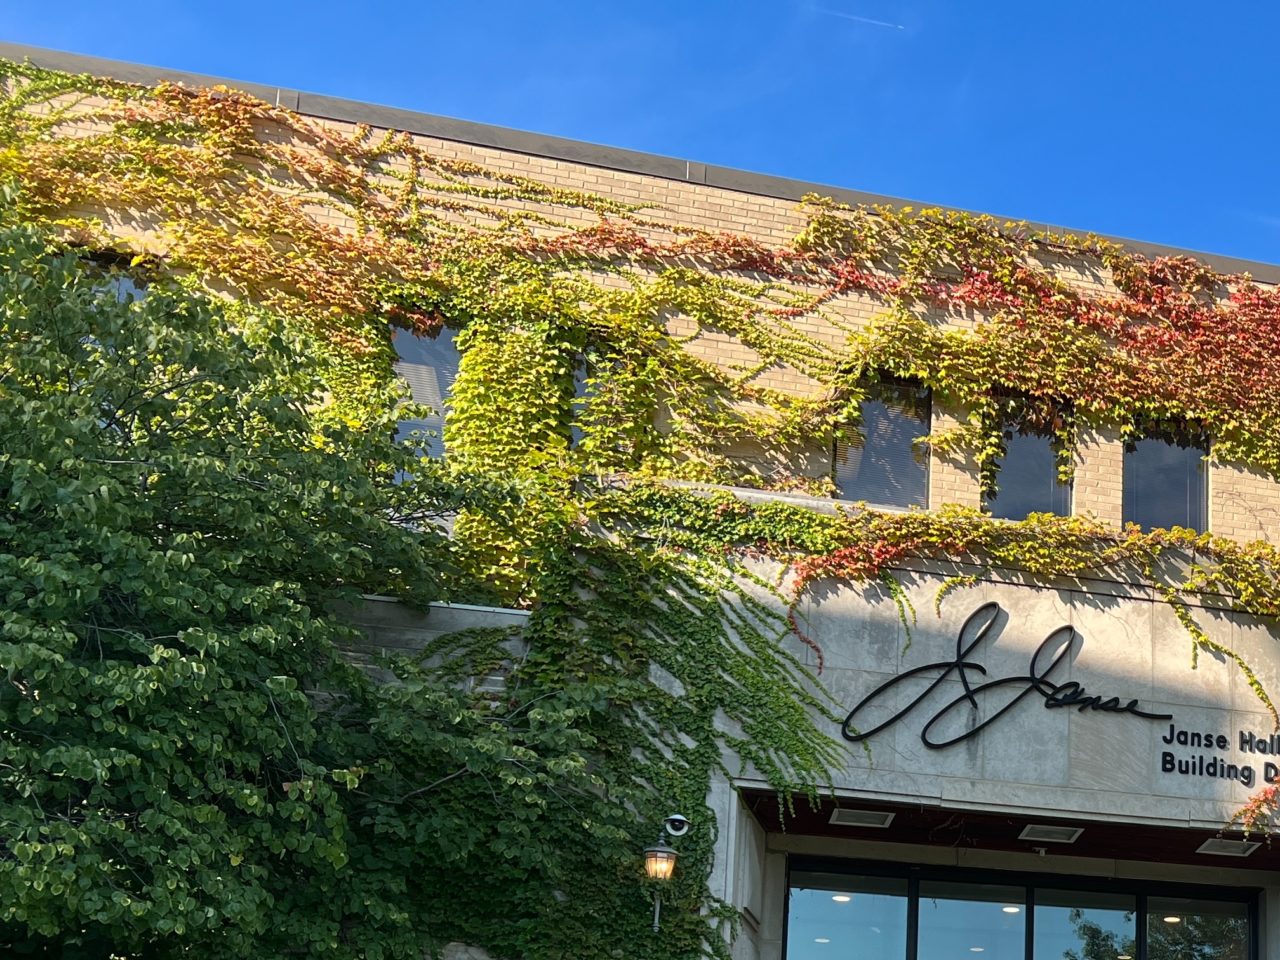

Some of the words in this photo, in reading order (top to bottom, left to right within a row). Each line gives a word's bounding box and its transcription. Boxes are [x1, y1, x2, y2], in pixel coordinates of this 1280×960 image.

[1162, 724, 1227, 750] Janse
[1239, 731, 1280, 755] Hall
[1162, 751, 1252, 787] Building
[1264, 762, 1279, 783] D
